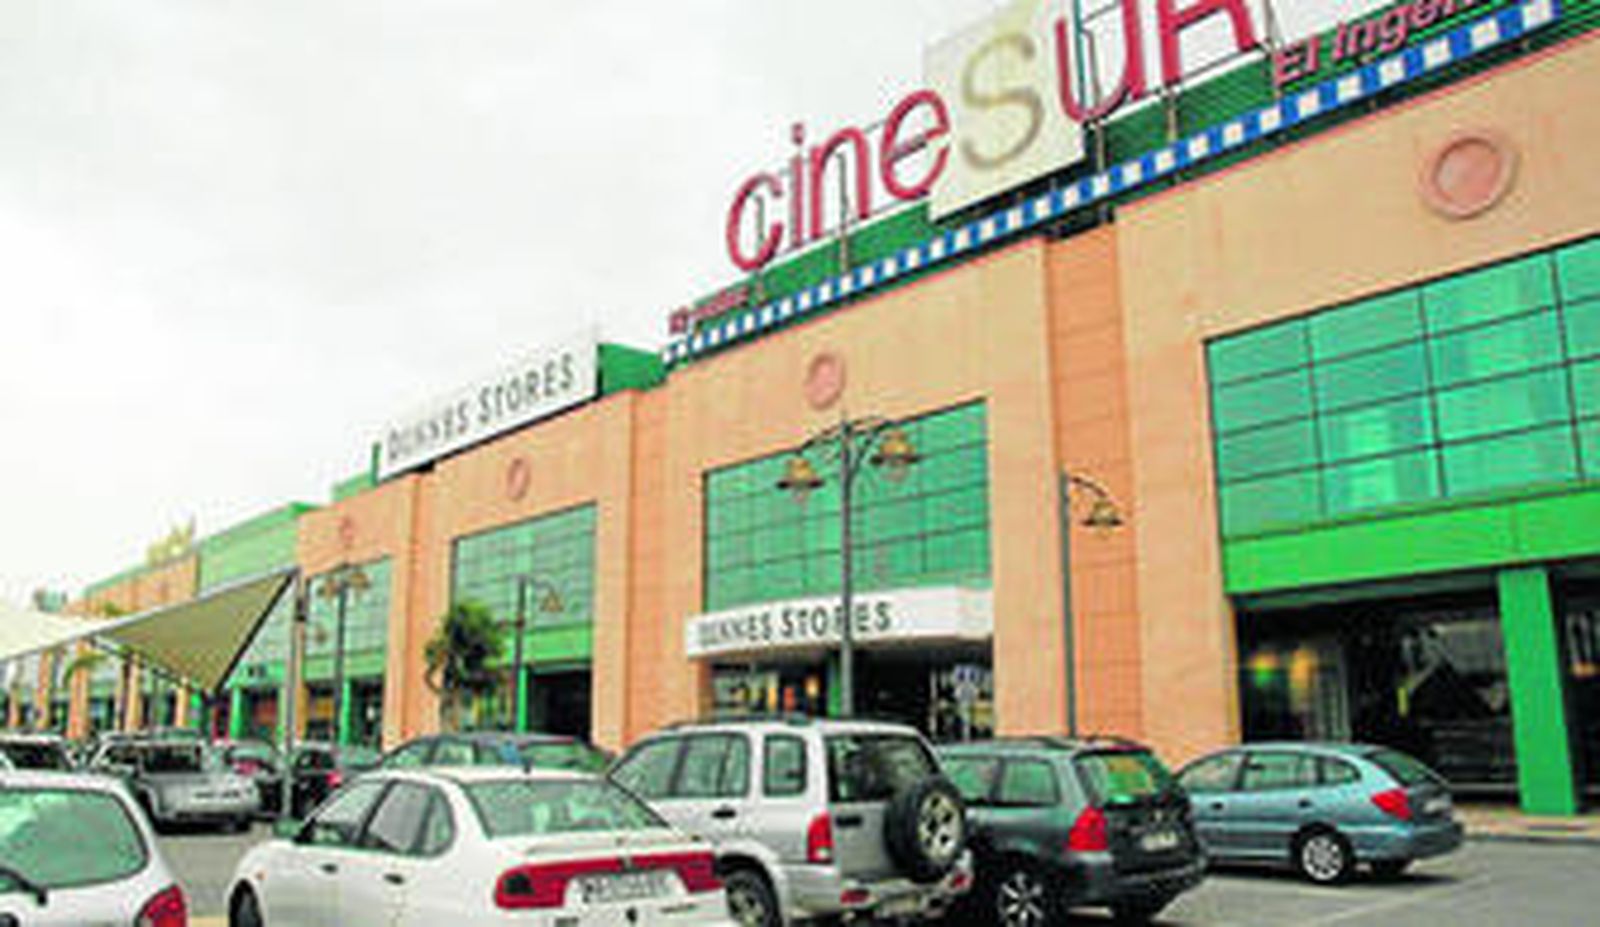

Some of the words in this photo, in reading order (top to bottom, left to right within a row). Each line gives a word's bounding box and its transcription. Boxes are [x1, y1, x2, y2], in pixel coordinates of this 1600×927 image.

[1273, 37, 1321, 86] El
[478, 353, 574, 425] STORES
[780, 602, 891, 639] STORES
